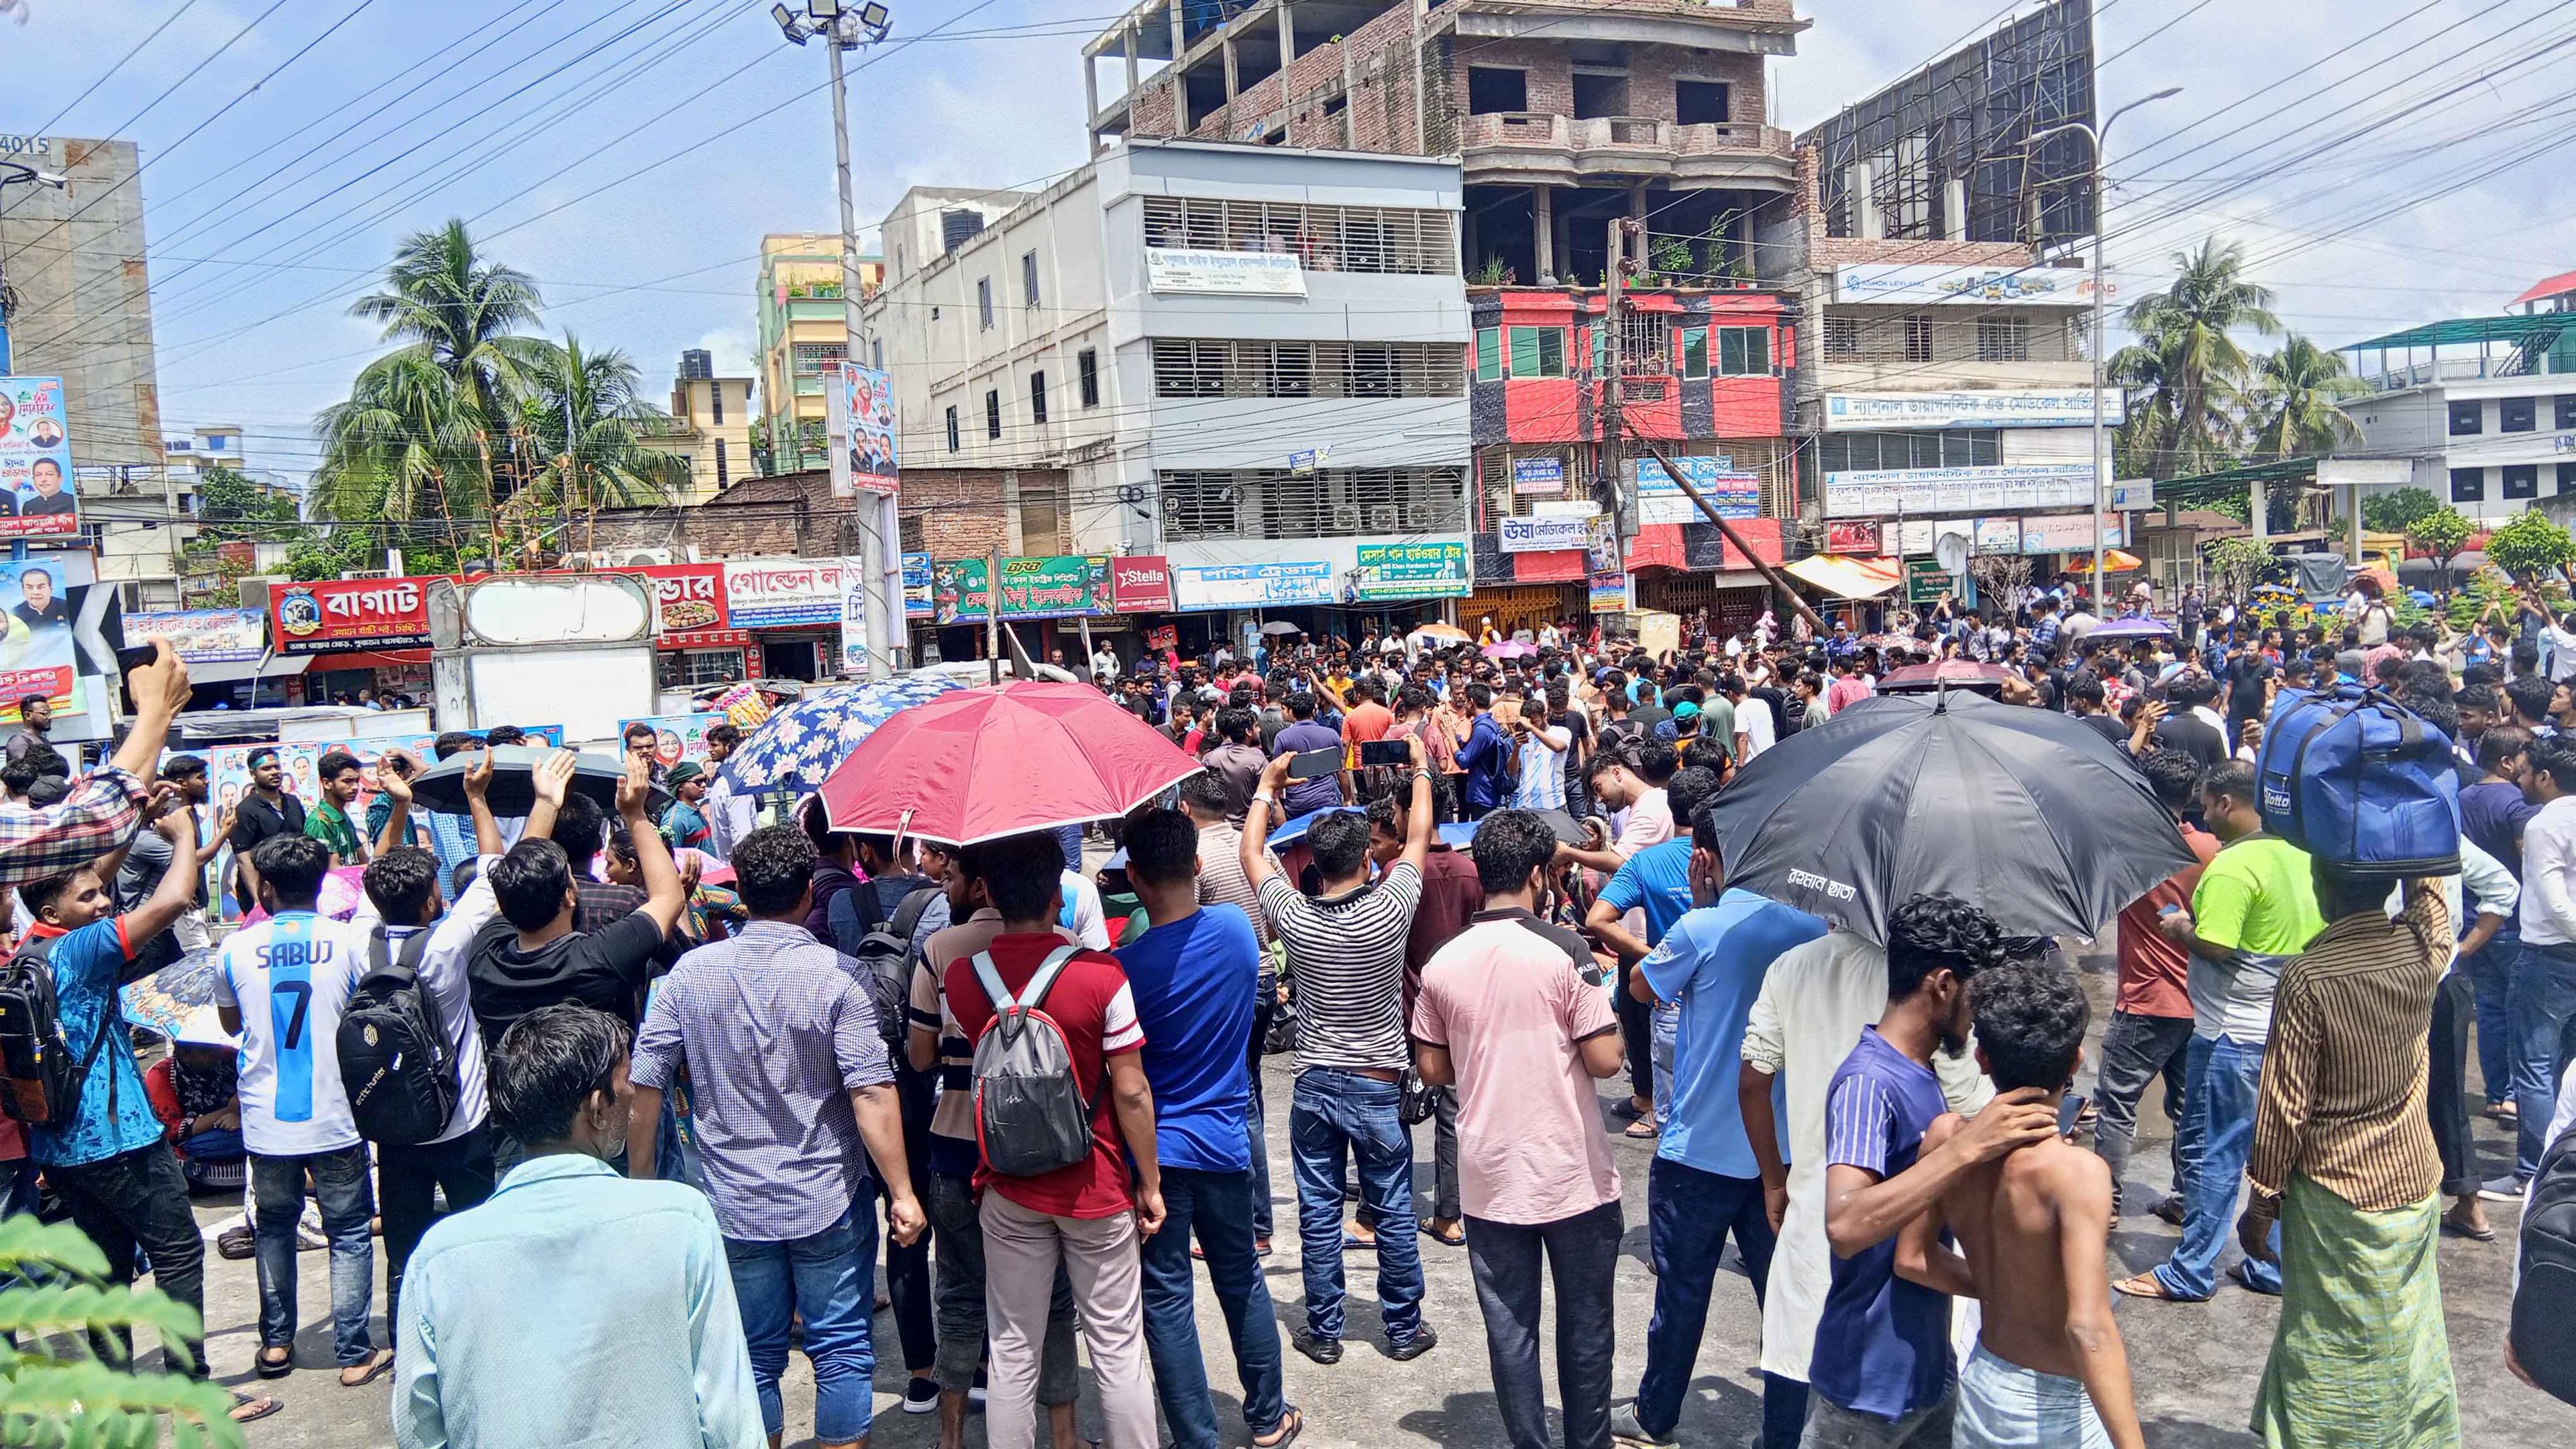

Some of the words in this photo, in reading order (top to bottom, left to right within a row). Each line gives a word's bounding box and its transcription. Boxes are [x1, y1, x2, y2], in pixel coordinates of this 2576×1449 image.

[1534, 521, 1576, 536] মেডিকেল
[731, 569, 816, 594] গোল্ডেন
[821, 567, 844, 591] লা
[1128, 570, 1165, 582] Stella
[323, 582, 420, 618] বাগাট
[966, 592, 989, 608] মেস
[1787, 868, 1828, 892] রহমান
[1827, 880, 1857, 902] ছাতা
[256, 941, 333, 969] SABUJ
[272, 980, 313, 1050] 7
[356, 1085, 371, 1106] arctic
[369, 1067, 386, 1089] hunter
